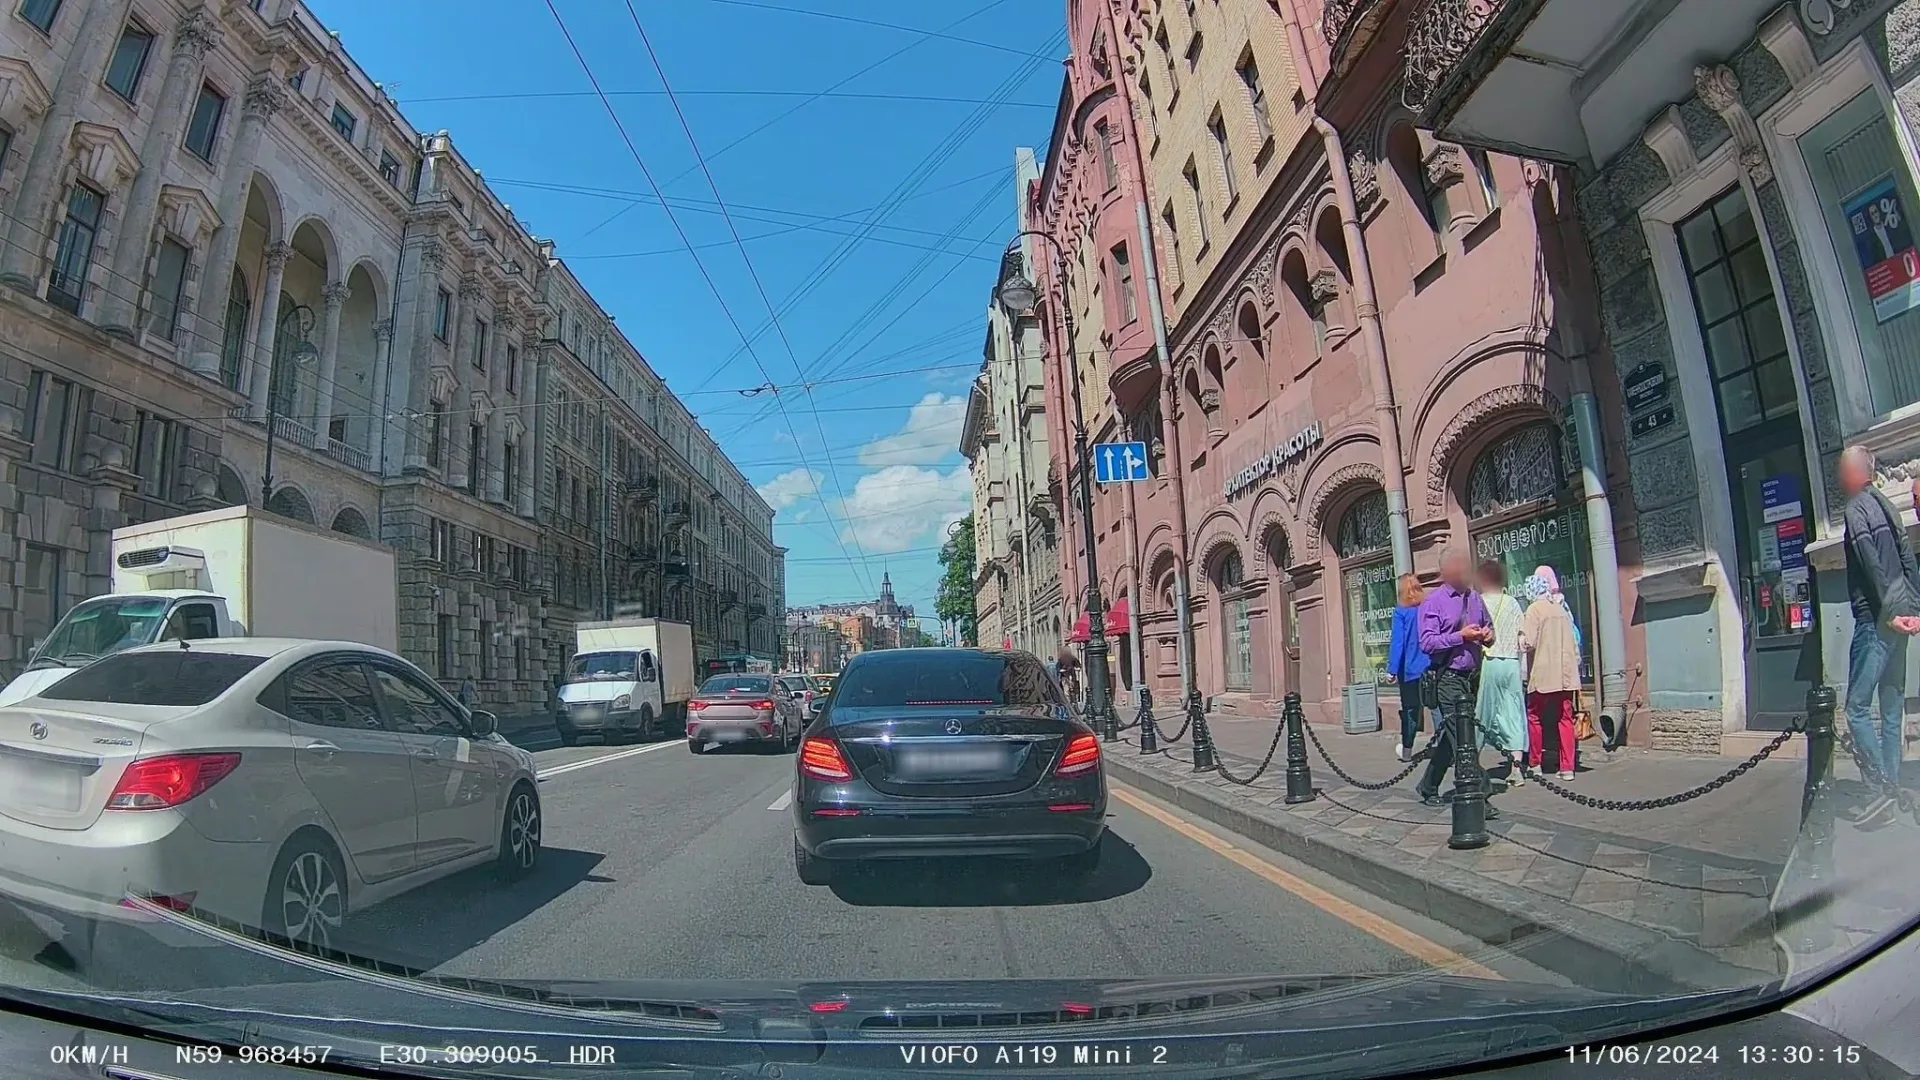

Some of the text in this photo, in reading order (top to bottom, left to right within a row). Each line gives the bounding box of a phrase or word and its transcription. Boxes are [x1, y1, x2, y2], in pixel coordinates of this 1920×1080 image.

[1647, 414, 1658, 428] 43
[1224, 421, 1323, 497] АРХИТЕКТОР КРАСОТЫ
